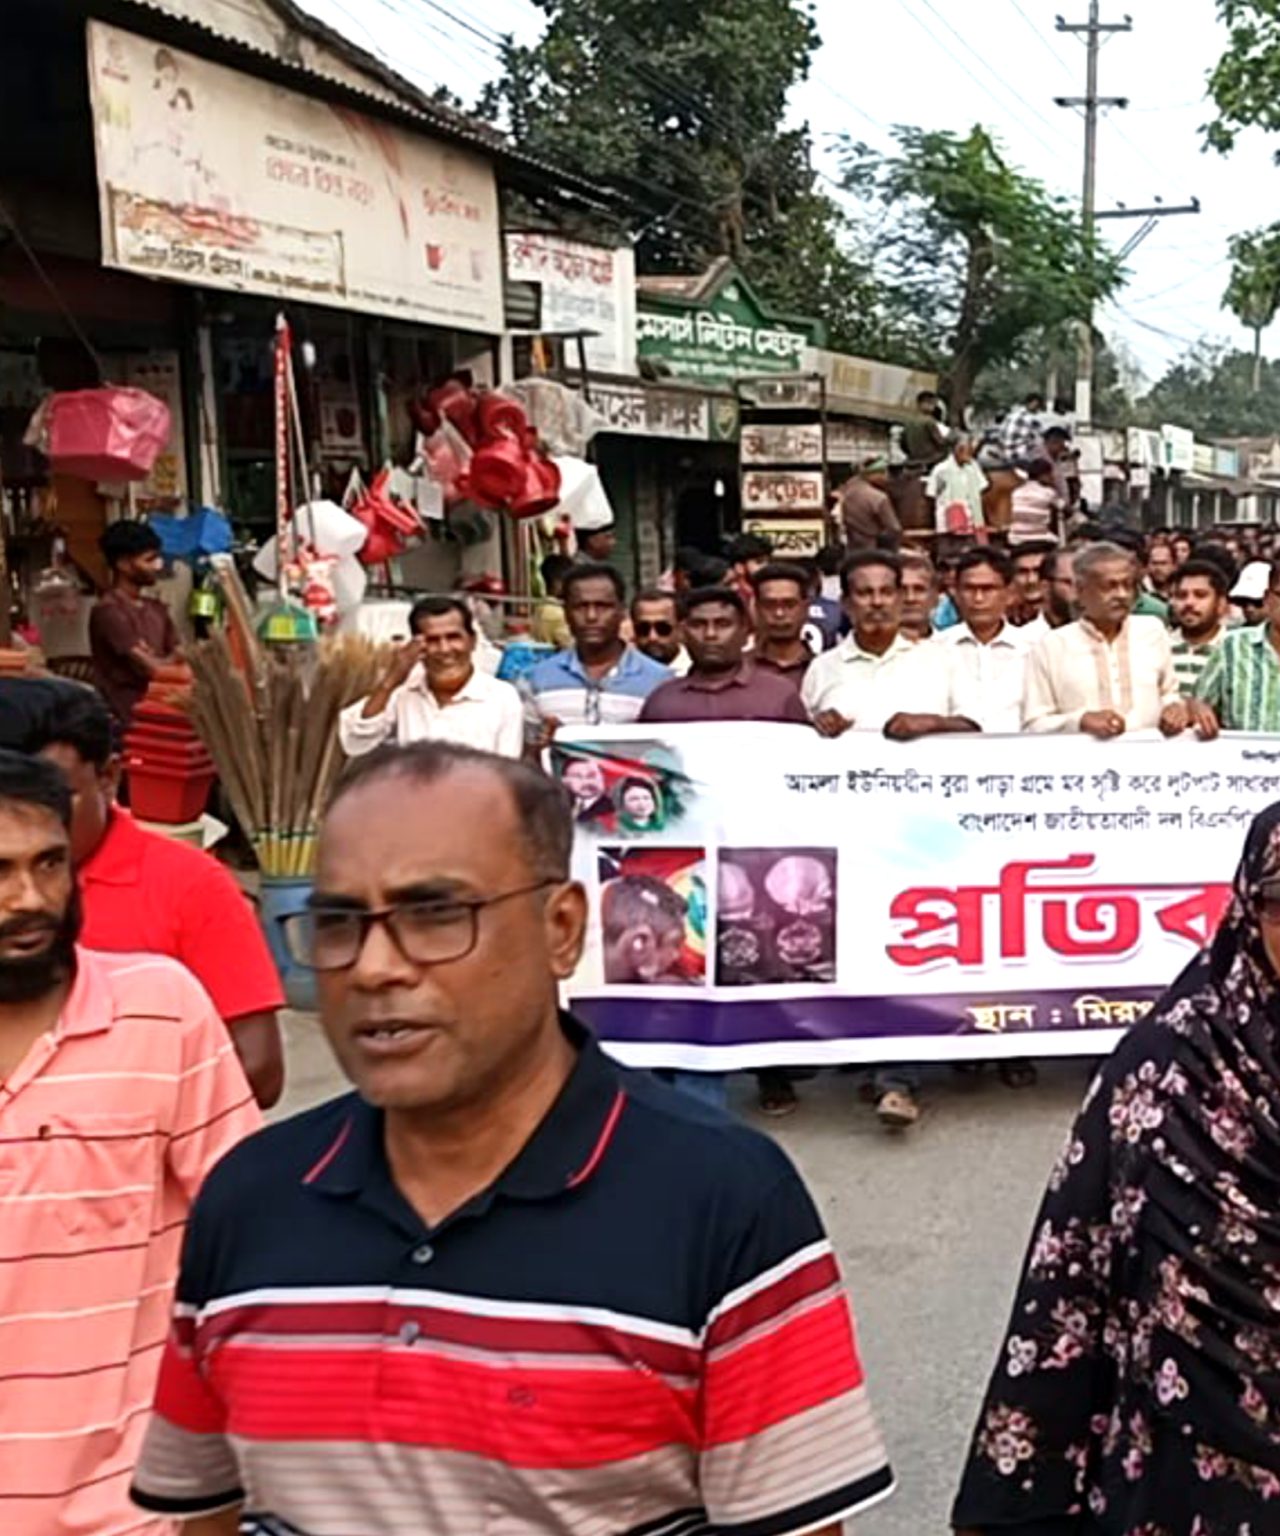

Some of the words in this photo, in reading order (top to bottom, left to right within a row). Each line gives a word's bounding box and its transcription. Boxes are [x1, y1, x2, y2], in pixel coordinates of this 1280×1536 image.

[1127, 774, 1162, 794] করে
[958, 812, 1037, 833] বাংলাদেশ
[1157, 812, 1184, 830] দল
[885, 853, 1233, 967] প্রতিব
[965, 1004, 1037, 1033] স্থান
[1073, 995, 1156, 1026] মিরপ
